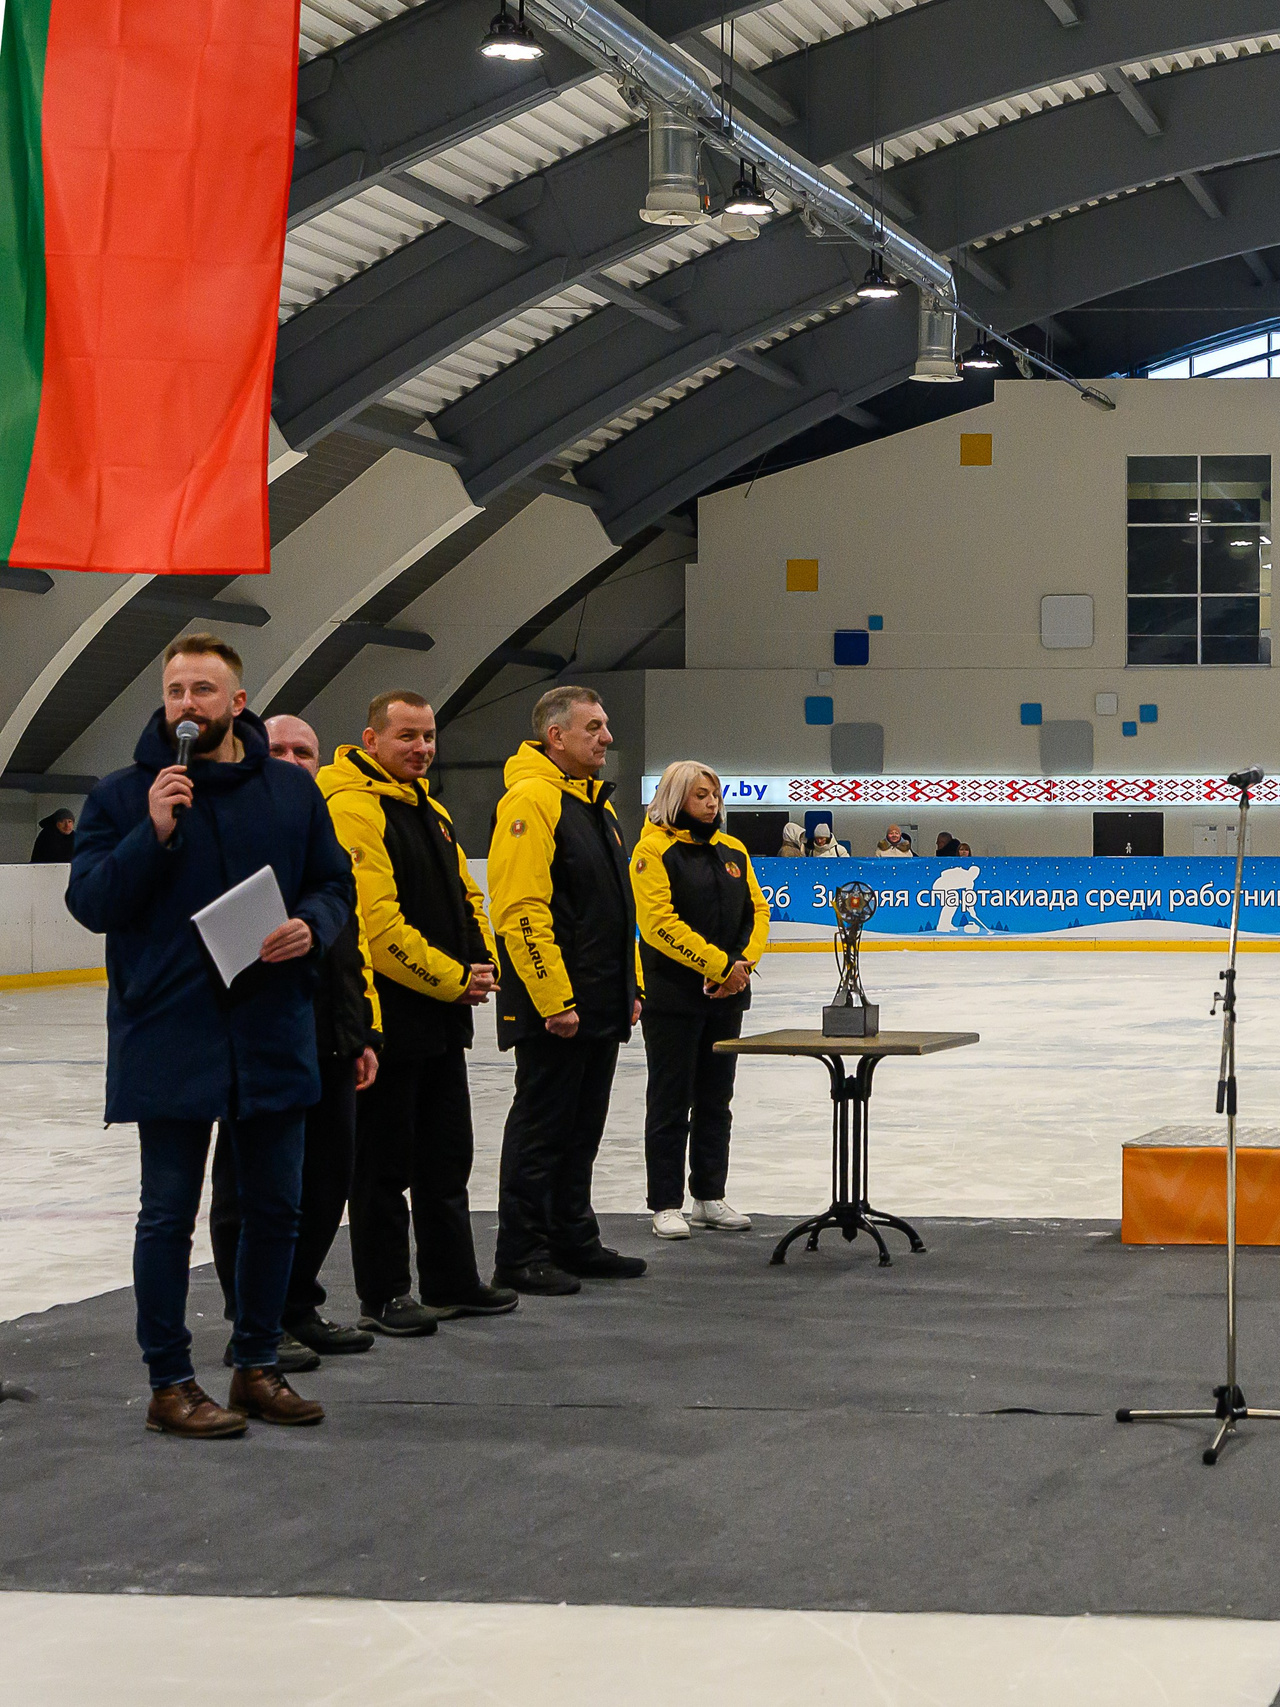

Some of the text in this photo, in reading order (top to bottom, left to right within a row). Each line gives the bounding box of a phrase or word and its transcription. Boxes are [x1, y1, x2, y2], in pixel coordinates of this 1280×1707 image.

[761, 885, 792, 908] 26
[916, 889, 1079, 912] спартакиада
[1085, 889, 1162, 912] среди
[387, 943, 440, 987] BELARUS
[520, 916, 548, 979] BELARUS
[657, 928, 708, 968] BELARUS
